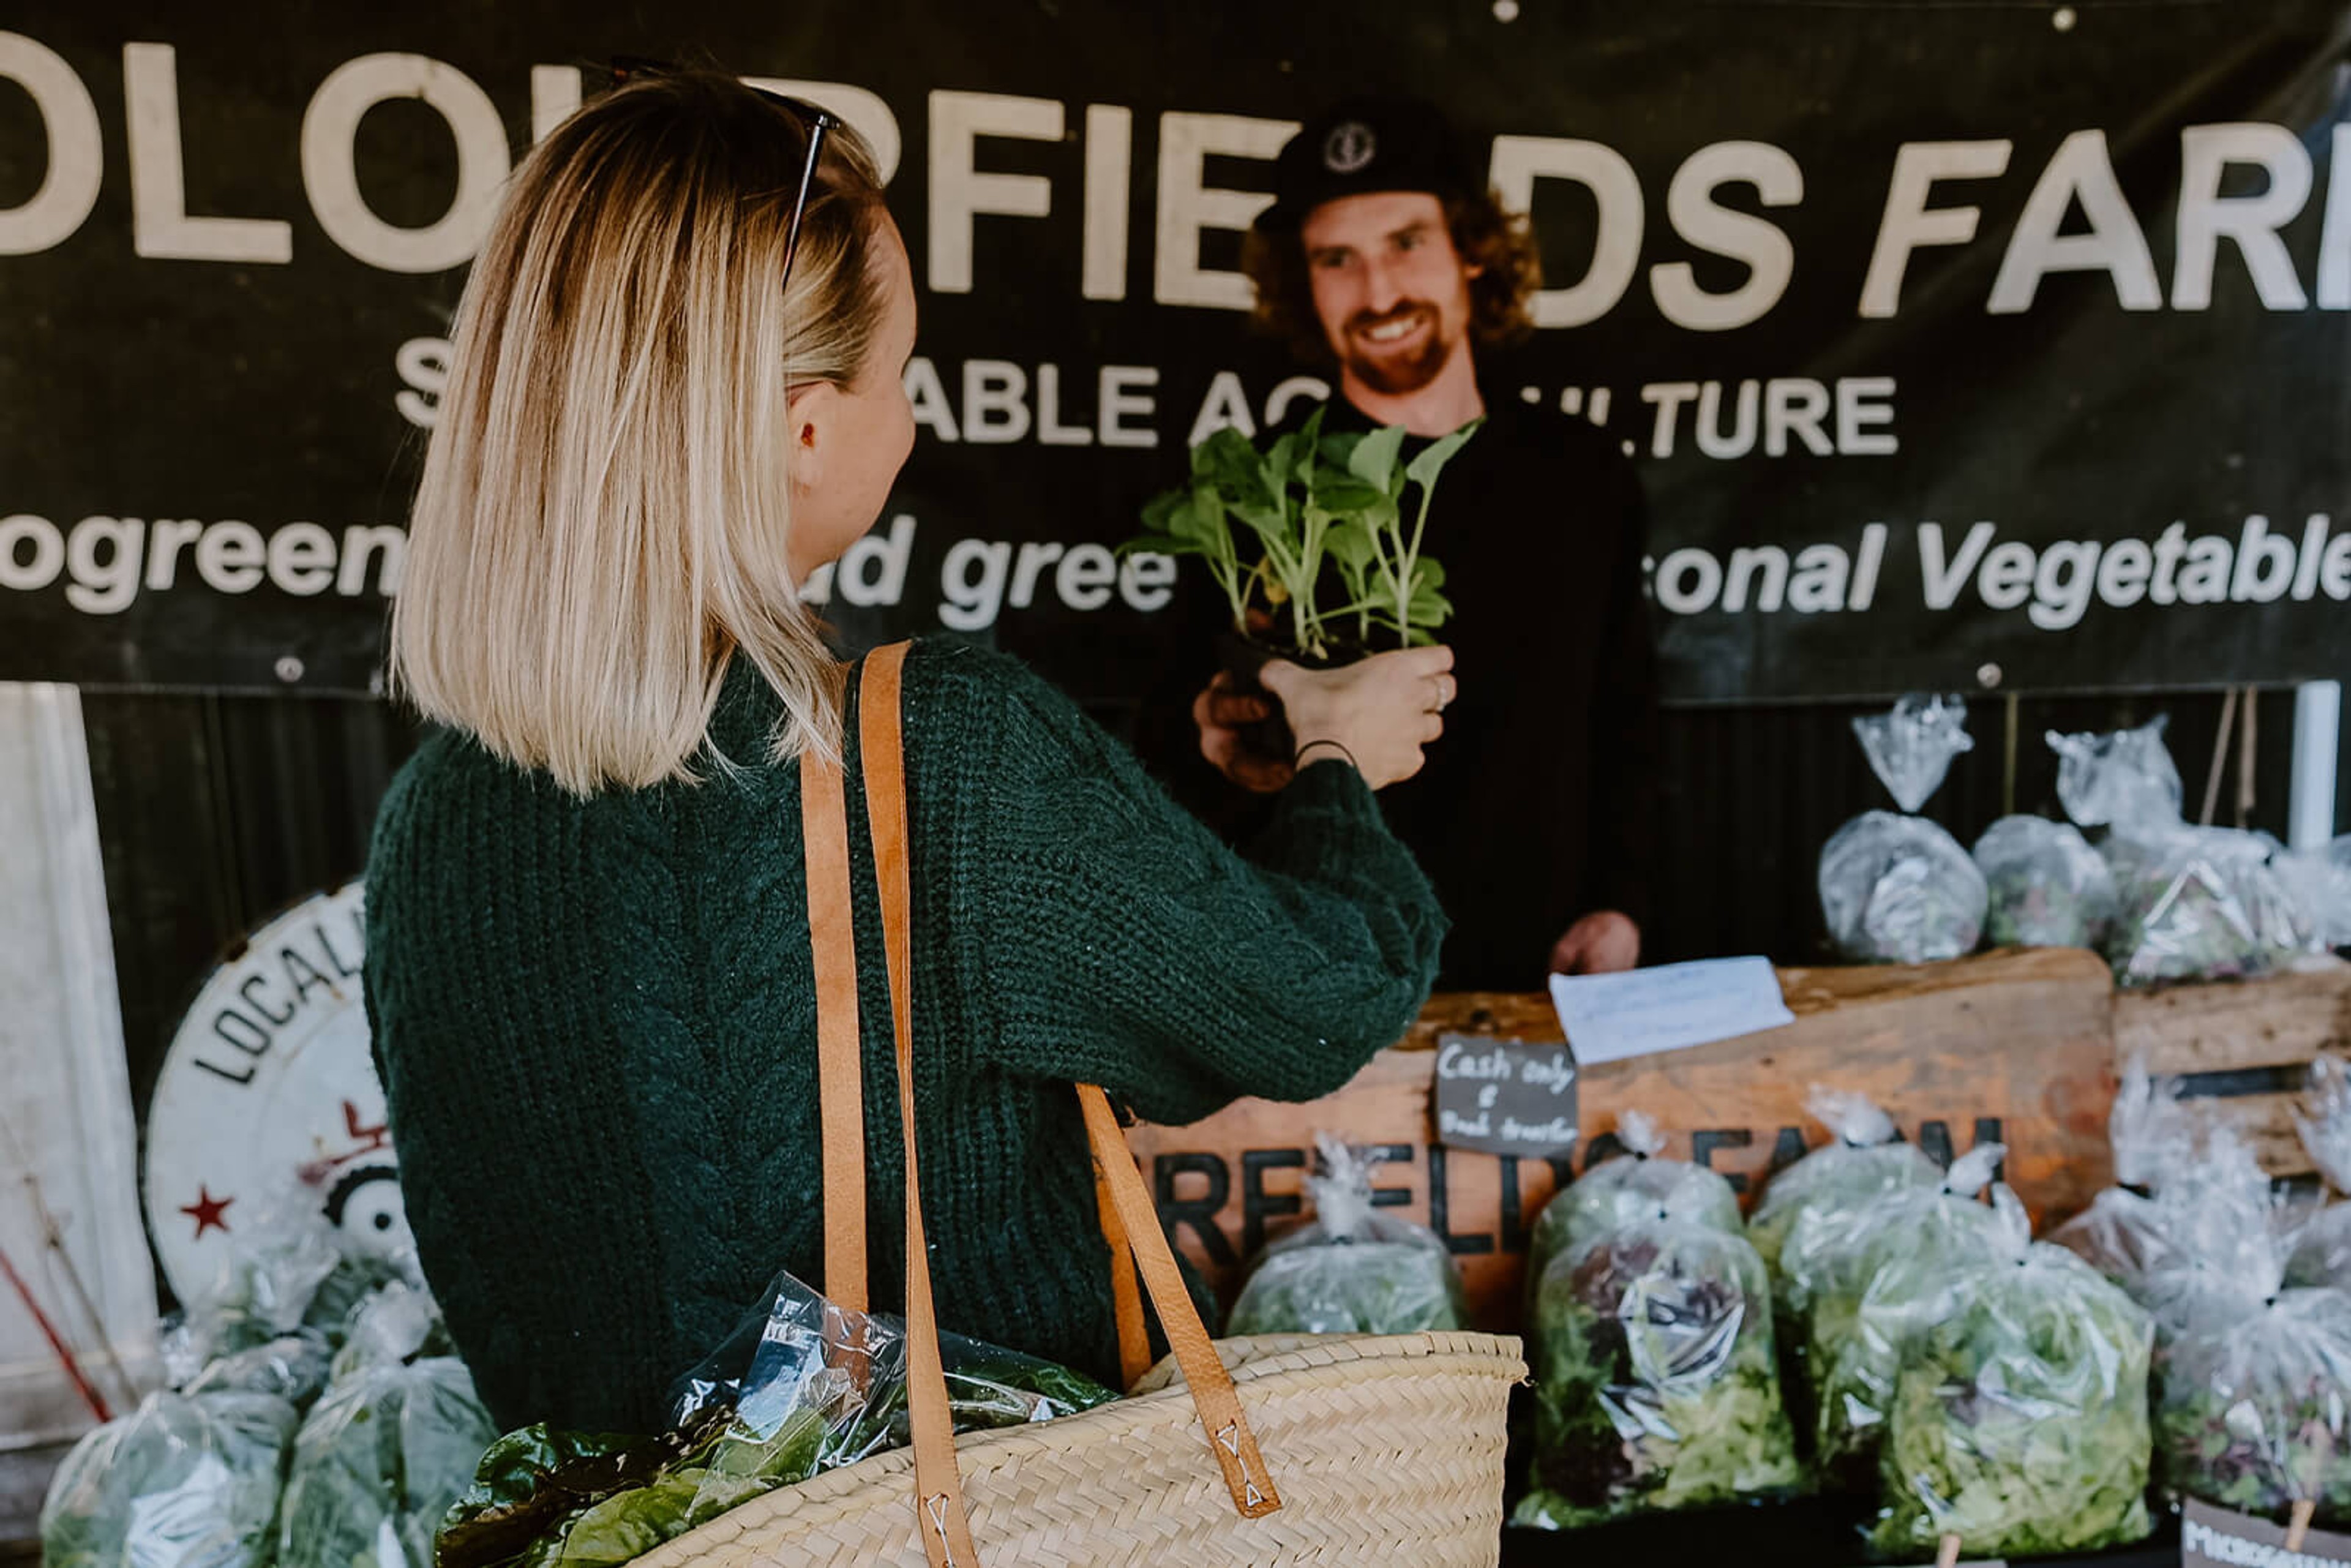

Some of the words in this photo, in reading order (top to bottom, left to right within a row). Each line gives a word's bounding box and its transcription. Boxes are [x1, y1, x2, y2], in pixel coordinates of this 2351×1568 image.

[1858, 122, 2351, 318] FAR
[0, 514, 408, 614] ogreen
[937, 538, 1177, 631] gree
[1641, 522, 1888, 614] onal
[192, 909, 366, 1086] LOCAL
[1438, 1043, 1512, 1080] Cash
